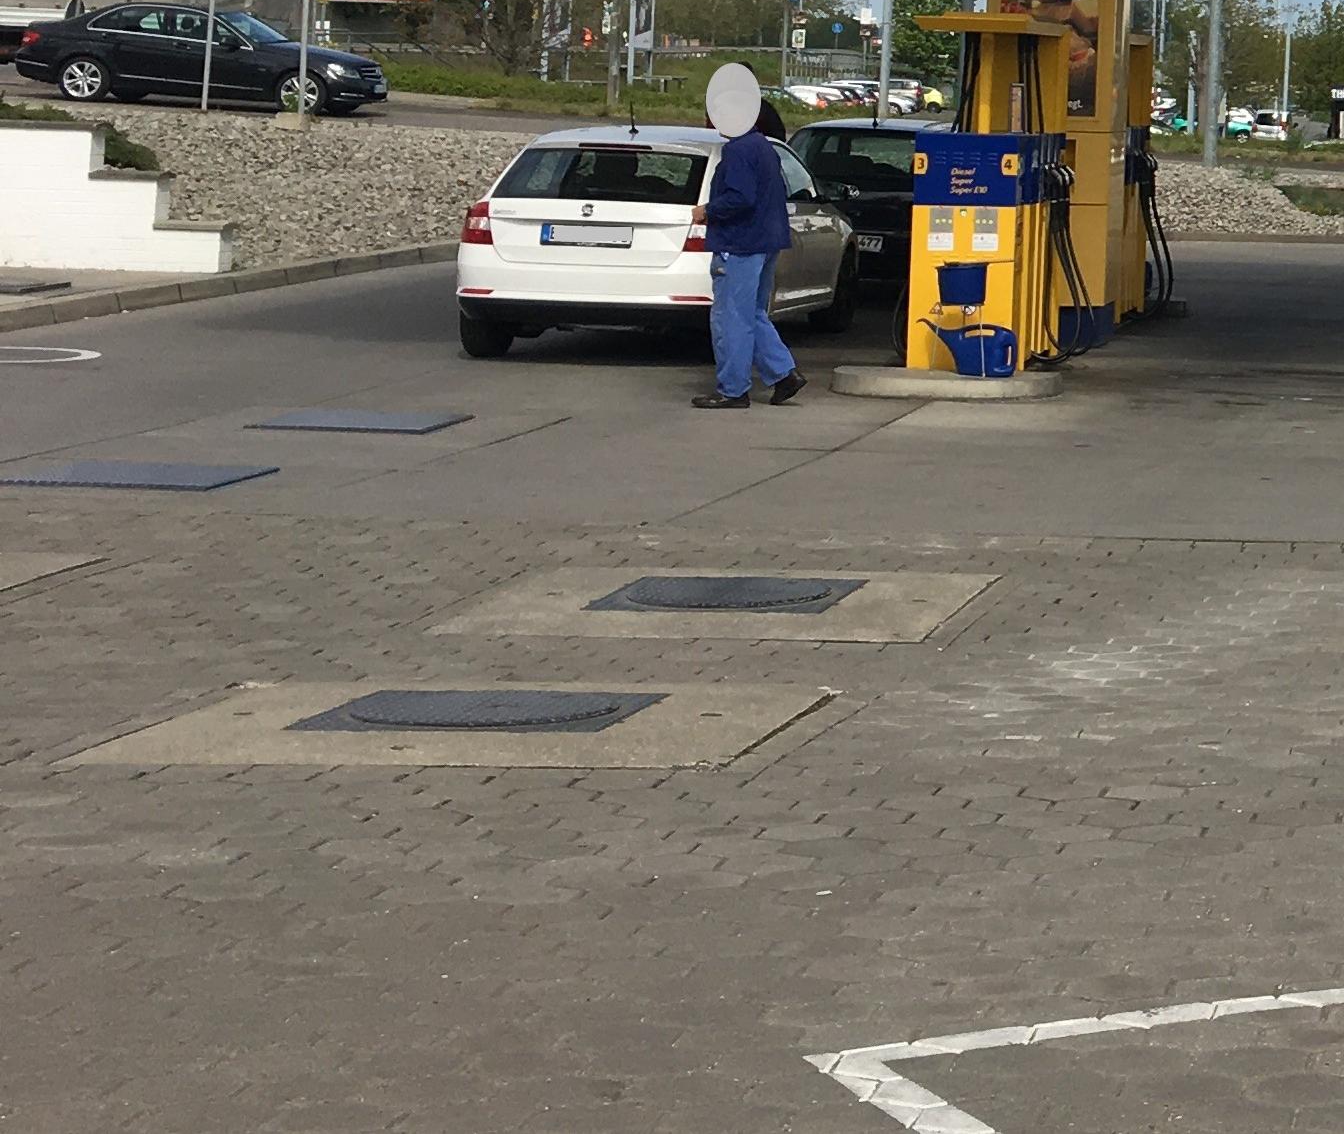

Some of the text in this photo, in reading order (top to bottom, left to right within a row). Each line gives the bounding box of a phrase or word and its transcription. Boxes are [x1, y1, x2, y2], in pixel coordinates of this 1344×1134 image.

[917, 157, 925, 170] 3
[1003, 158, 1013, 170] 4
[950, 167, 976, 176] Diesel
[950, 176, 974, 186] Super
[949, 185, 972, 196] Super
